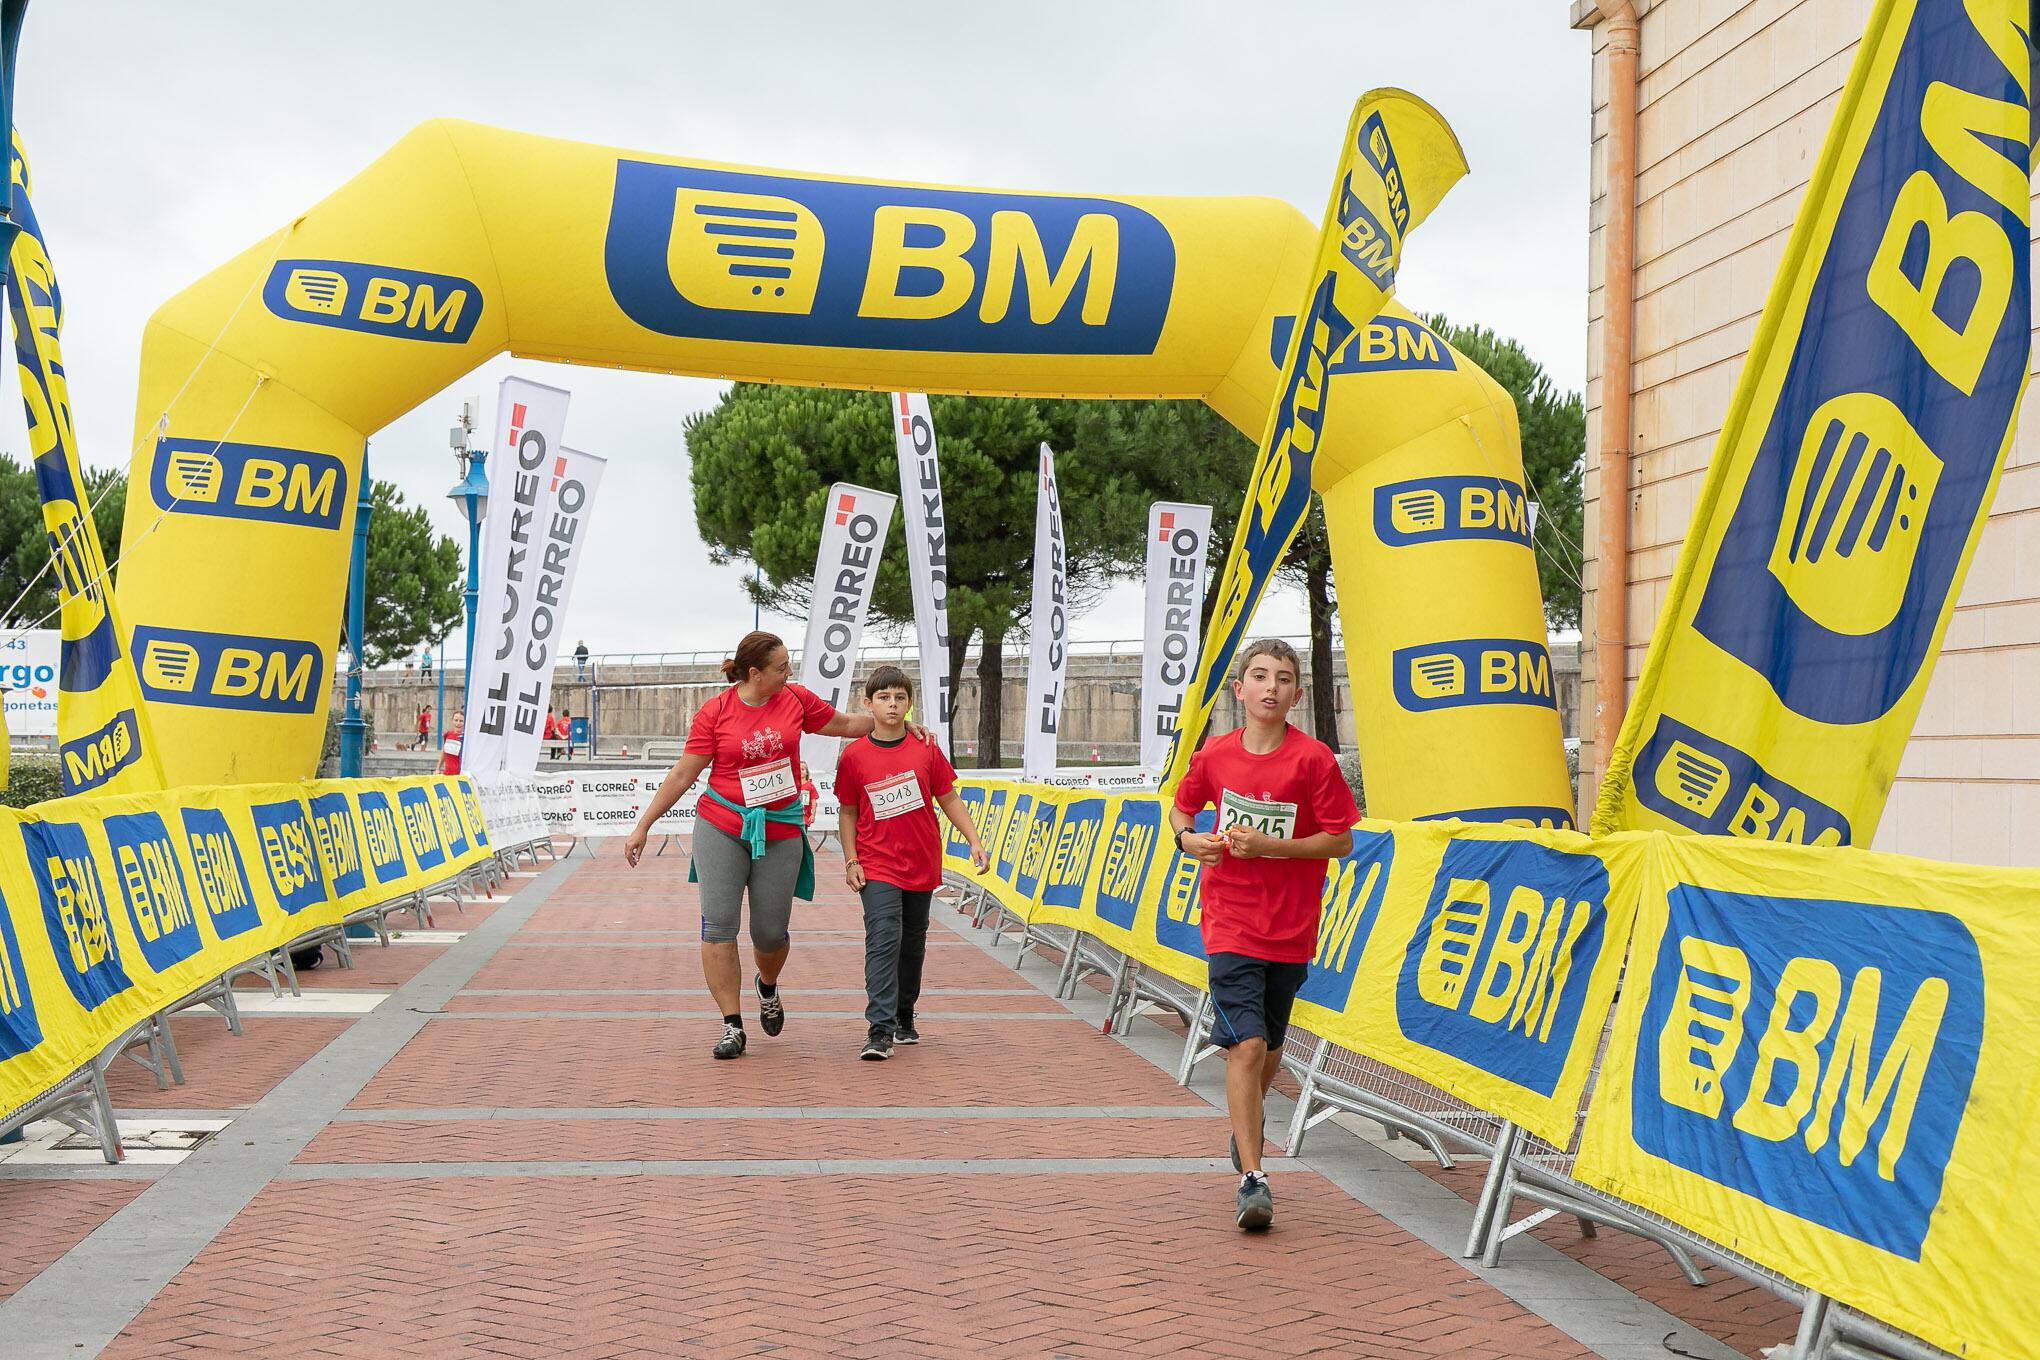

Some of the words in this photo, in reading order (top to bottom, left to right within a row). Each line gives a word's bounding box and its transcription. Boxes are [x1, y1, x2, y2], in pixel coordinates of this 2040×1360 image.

[1386, 167, 1406, 231] BM
[857, 205, 1119, 326] BM
[1343, 216, 1394, 278] BM
[359, 278, 467, 333] BM
[1359, 324, 1439, 362] BM
[235, 458, 338, 517] BM
[1459, 487, 1528, 537] BM
[479, 672, 509, 736] EL
[495, 430, 546, 660] CORREO
[525, 479, 586, 670] CORREO
[819, 514, 878, 679] CORREO
[1049, 477, 1066, 671] CORREO
[1160, 528, 1199, 686] CORREO
[210, 647, 314, 702] BM
[1480, 649, 1551, 698] BM
[514, 681, 541, 735] EL
[1041, 681, 1058, 733] EL
[1157, 693, 1183, 736] EL
[582, 783, 594, 792] EL
[595, 783, 635, 792] CORREO
[747, 773, 783, 792] 3018
[820, 782, 831, 790] EL
[874, 785, 912, 806] 3018
[1107, 777, 1143, 785] CORREO
[373, 808, 400, 865] BM
[413, 802, 439, 854] BM
[583, 812, 595, 820] EL
[596, 811, 636, 820] CORREO
[825, 807, 836, 815] EL
[206, 831, 248, 912] BM
[329, 811, 360, 877] BM
[1062, 818, 1100, 887] BM
[1111, 824, 1154, 904] BM
[140, 838, 191, 936] BM
[1469, 885, 1590, 1044] BM
[1733, 957, 1949, 1182] BM
